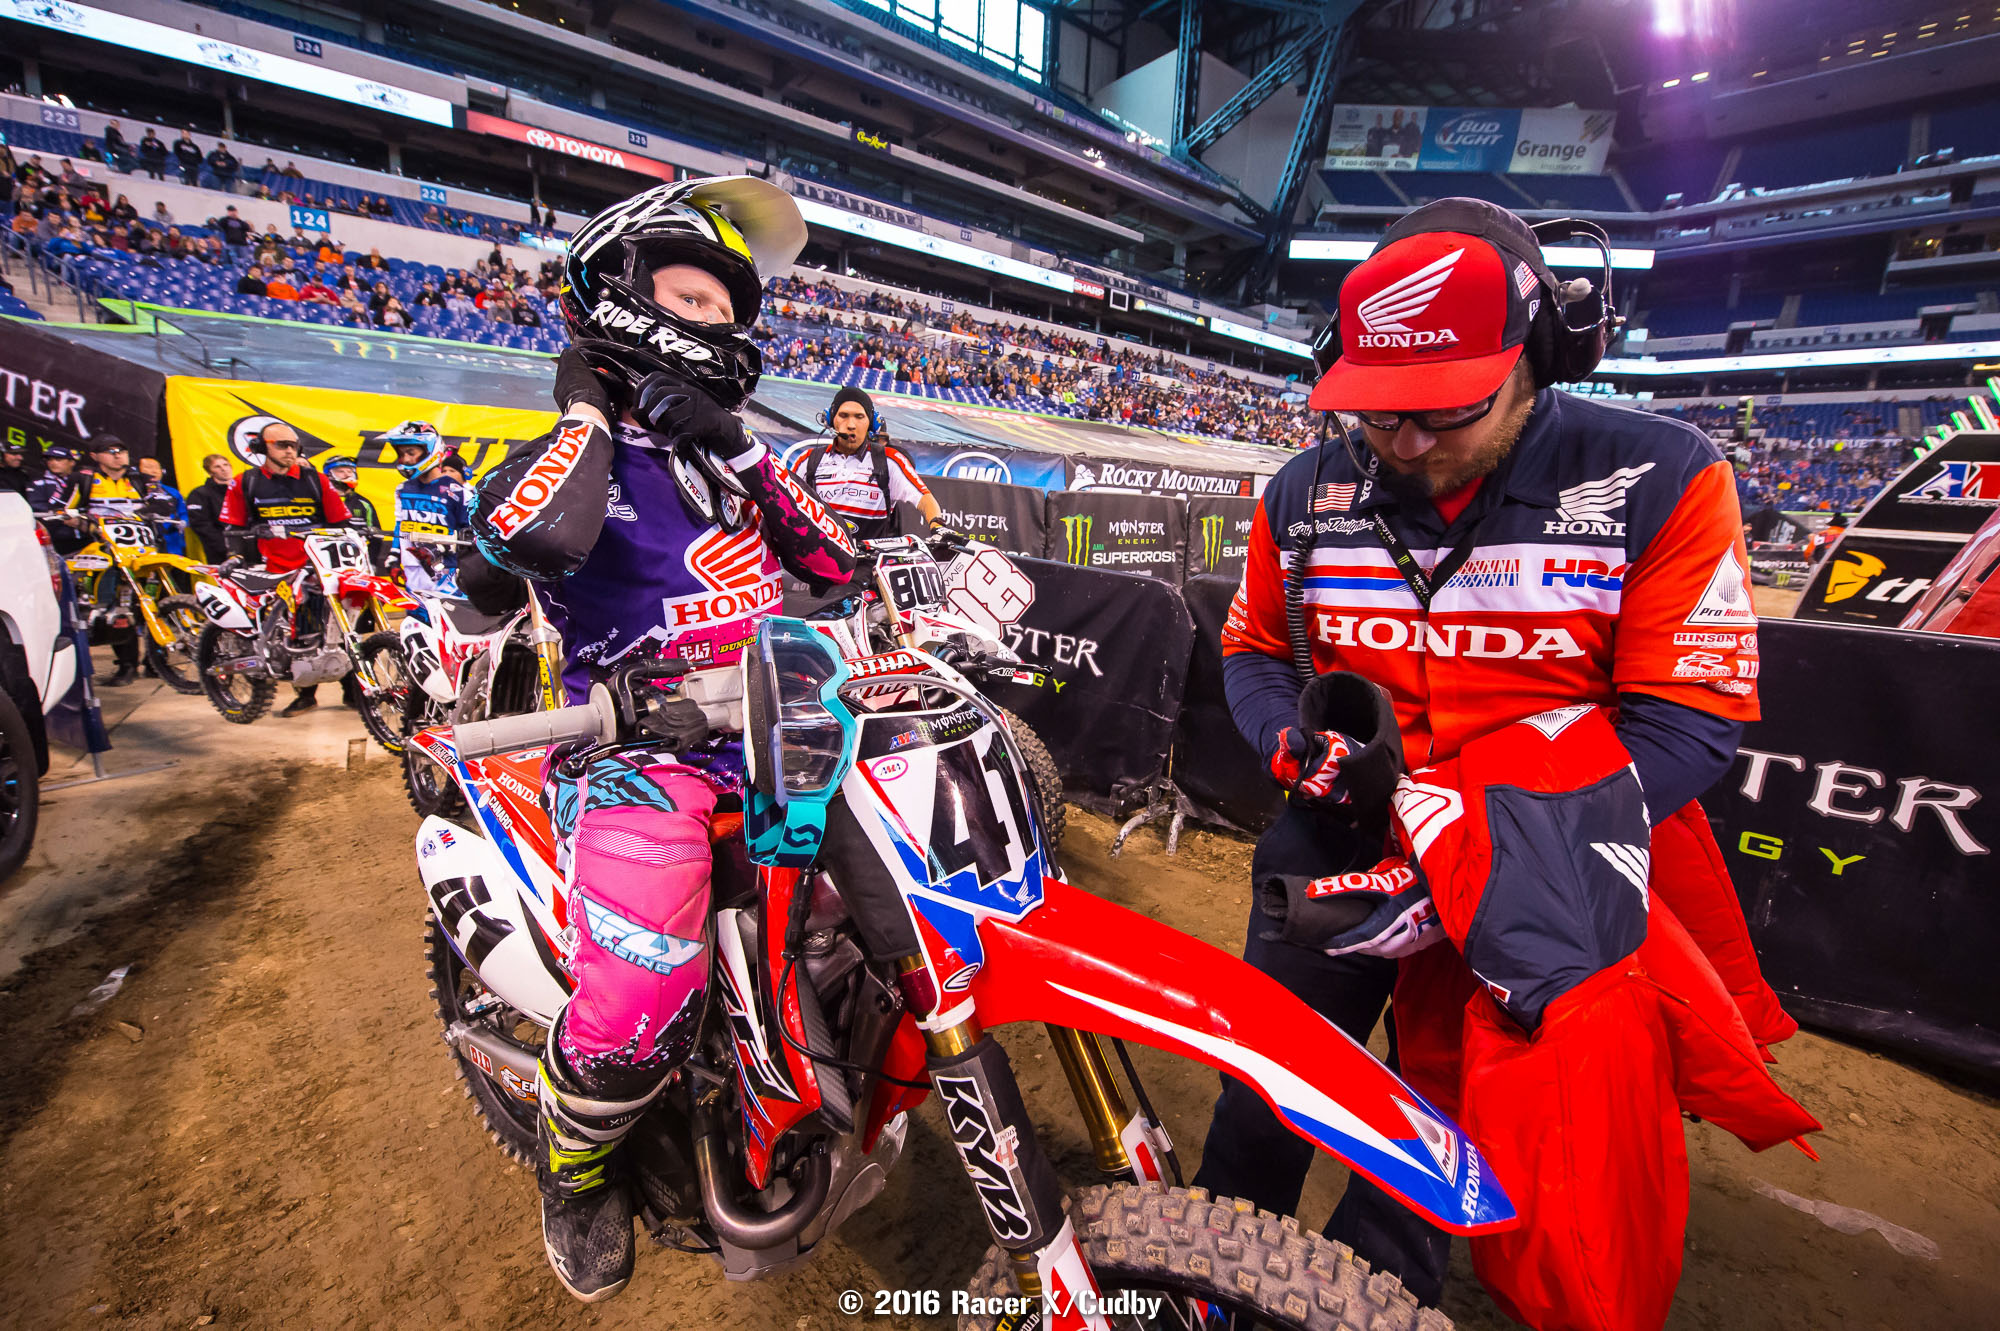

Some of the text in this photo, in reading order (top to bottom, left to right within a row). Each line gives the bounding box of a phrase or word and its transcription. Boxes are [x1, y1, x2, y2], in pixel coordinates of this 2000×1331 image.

[43, 109, 79, 127] 223
[1458, 120, 1501, 133] BUD
[1447, 133, 1505, 146] LIGHT
[1517, 140, 1587, 160] Grange
[556, 137, 625, 168] TOYOTA
[421, 187, 446, 202] 224
[293, 210, 327, 230] 124
[1074, 282, 1104, 297] SHARP
[590, 301, 656, 333] RIDE
[648, 325, 713, 360] RED
[1358, 329, 1460, 348] HONDA
[0, 368, 91, 439] TER
[489, 423, 592, 539] HONDA
[1099, 463, 1241, 495] ROCKY MOUNTAIN
[258, 506, 316, 517] GEICO
[770, 455, 854, 556] HONDA
[267, 518, 311, 526] HONDA
[1109, 519, 1165, 536] MONSTER
[1329, 516, 1375, 535] Designs
[113, 525, 156, 546] 28
[320, 542, 363, 569] 19
[199, 593, 231, 620] 19
[672, 579, 784, 627] HONDA
[1699, 607, 1723, 617] Pro
[1316, 613, 1586, 660] HONDA
[1675, 633, 1735, 643] HINSON
[930, 709, 977, 731] MONSTER
[889, 729, 919, 751] AMA
[428, 742, 458, 766] DUNLOP
[880, 763, 902, 776] AMA
[496, 772, 542, 809] HONDA
[1736, 746, 1991, 856] TER
[488, 795, 513, 821] CANARD
[927, 731, 1038, 888] 41
[436, 829, 457, 849] AMA
[1738, 831, 1867, 876] GY
[1314, 866, 1415, 895] HOND
[590, 932, 673, 976] RACING
[935, 1075, 1032, 1241] KYB
[1461, 1141, 1481, 1220] HONDA
